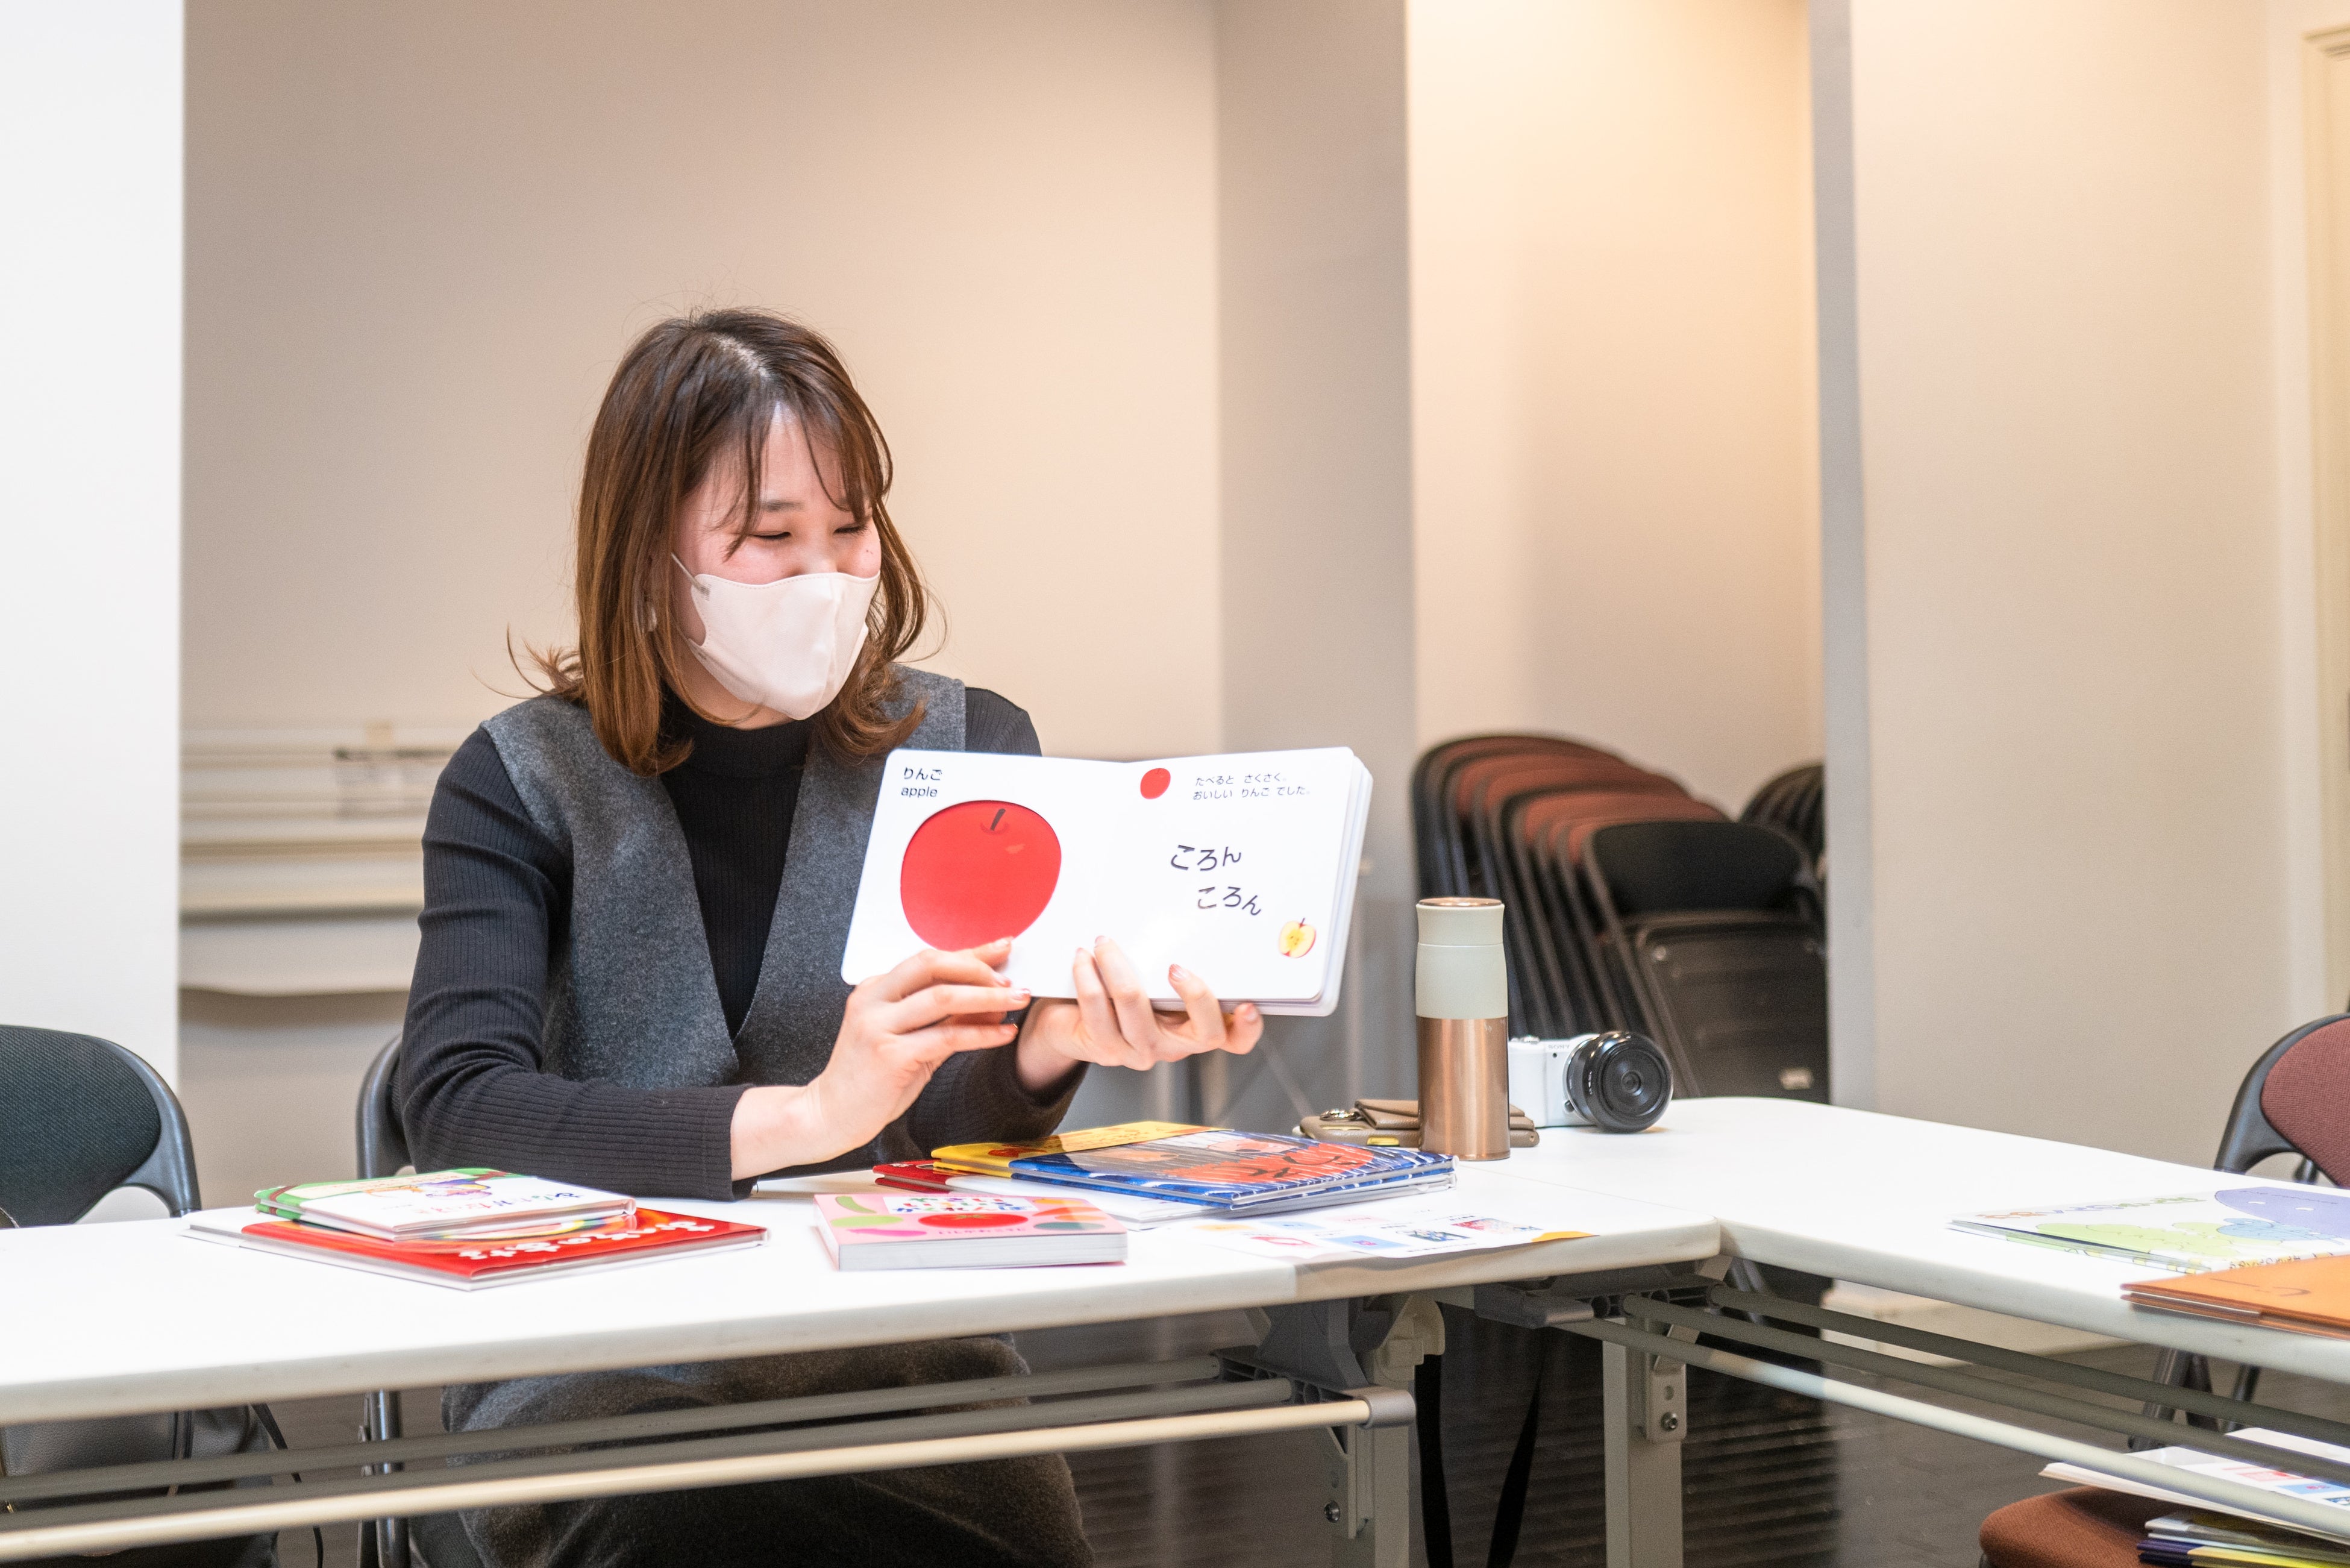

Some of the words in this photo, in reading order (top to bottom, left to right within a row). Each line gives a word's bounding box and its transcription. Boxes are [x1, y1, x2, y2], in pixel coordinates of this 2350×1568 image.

[903, 767, 943, 781] りんご
[1195, 775, 1235, 786] たべると
[900, 786, 938, 798] apple
[1192, 790, 1233, 800] おいしい
[1241, 787, 1270, 798] りんご
[1170, 844, 1241, 871] ころん
[1197, 886, 1262, 916] ころん
